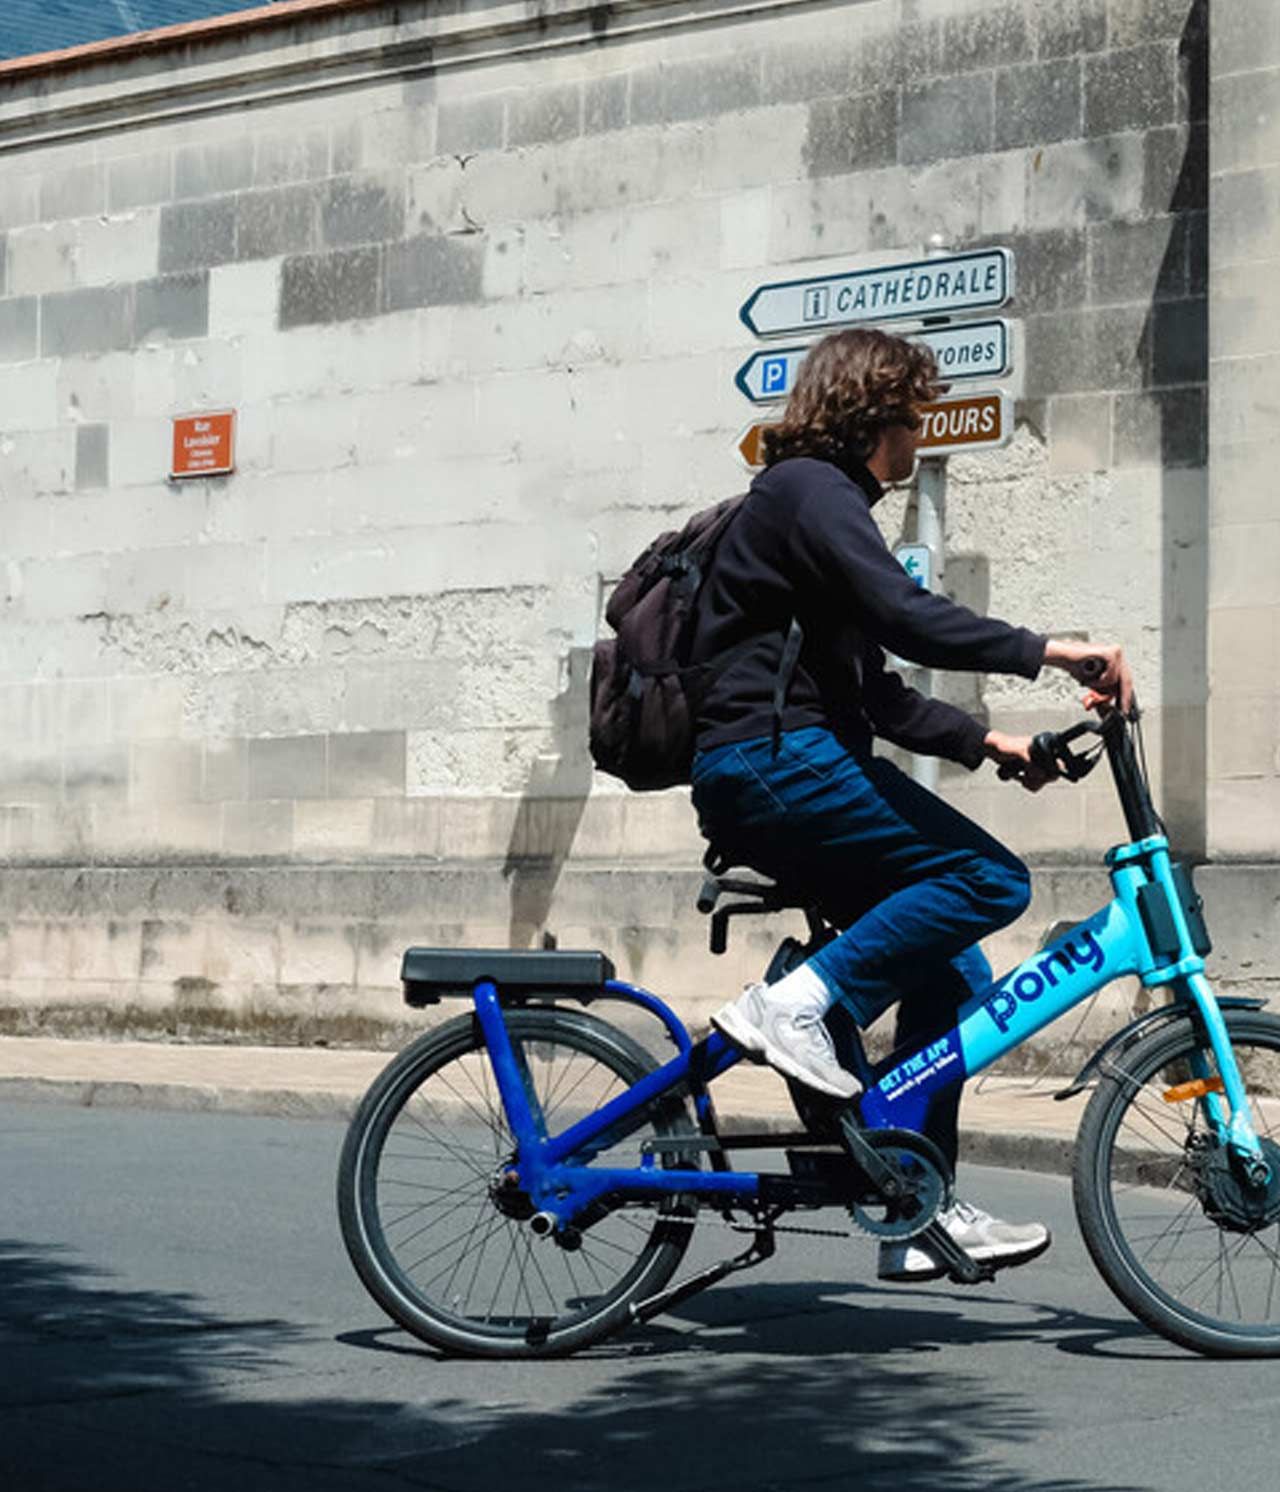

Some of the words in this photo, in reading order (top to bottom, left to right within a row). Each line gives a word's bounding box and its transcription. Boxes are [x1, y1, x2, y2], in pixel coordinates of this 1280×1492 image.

[837, 265, 997, 312] CATHÉDRALE
[766, 363, 783, 389] P
[936, 341, 996, 365] rones
[919, 405, 996, 440] TOURS
[984, 930, 1105, 1034] pony
[878, 1067, 902, 1092] GET
[902, 1051, 927, 1076] THE
[926, 1038, 949, 1062] APP
